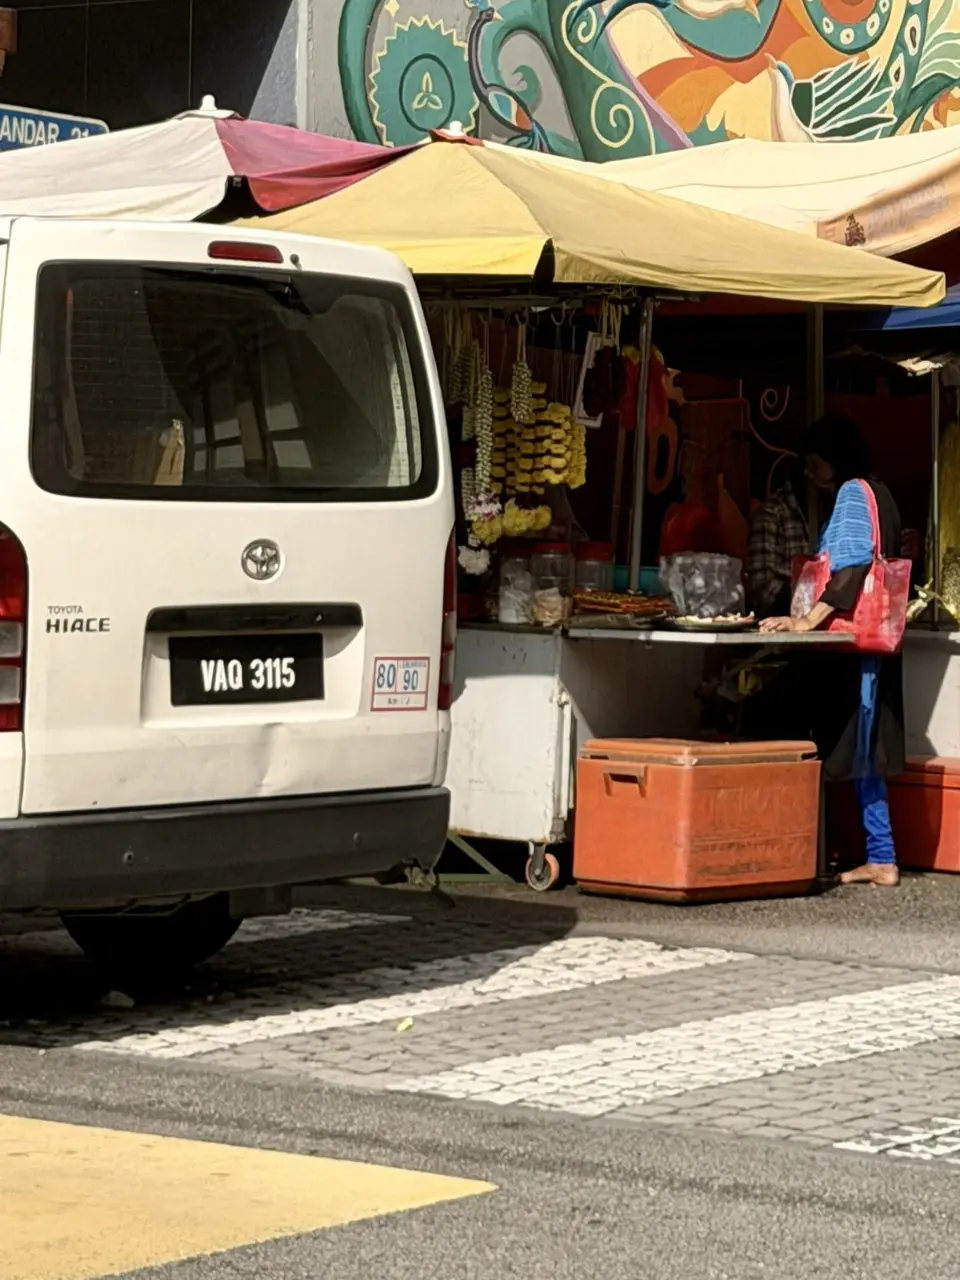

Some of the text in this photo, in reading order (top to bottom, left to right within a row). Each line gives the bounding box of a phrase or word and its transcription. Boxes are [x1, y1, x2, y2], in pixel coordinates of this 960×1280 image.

[48, 605, 83, 615] TOYOTA
[46, 618, 110, 633] HIACE
[200, 657, 296, 692] VAQ 3115
[377, 663, 396, 689] 80
[403, 669, 418, 691] 90
